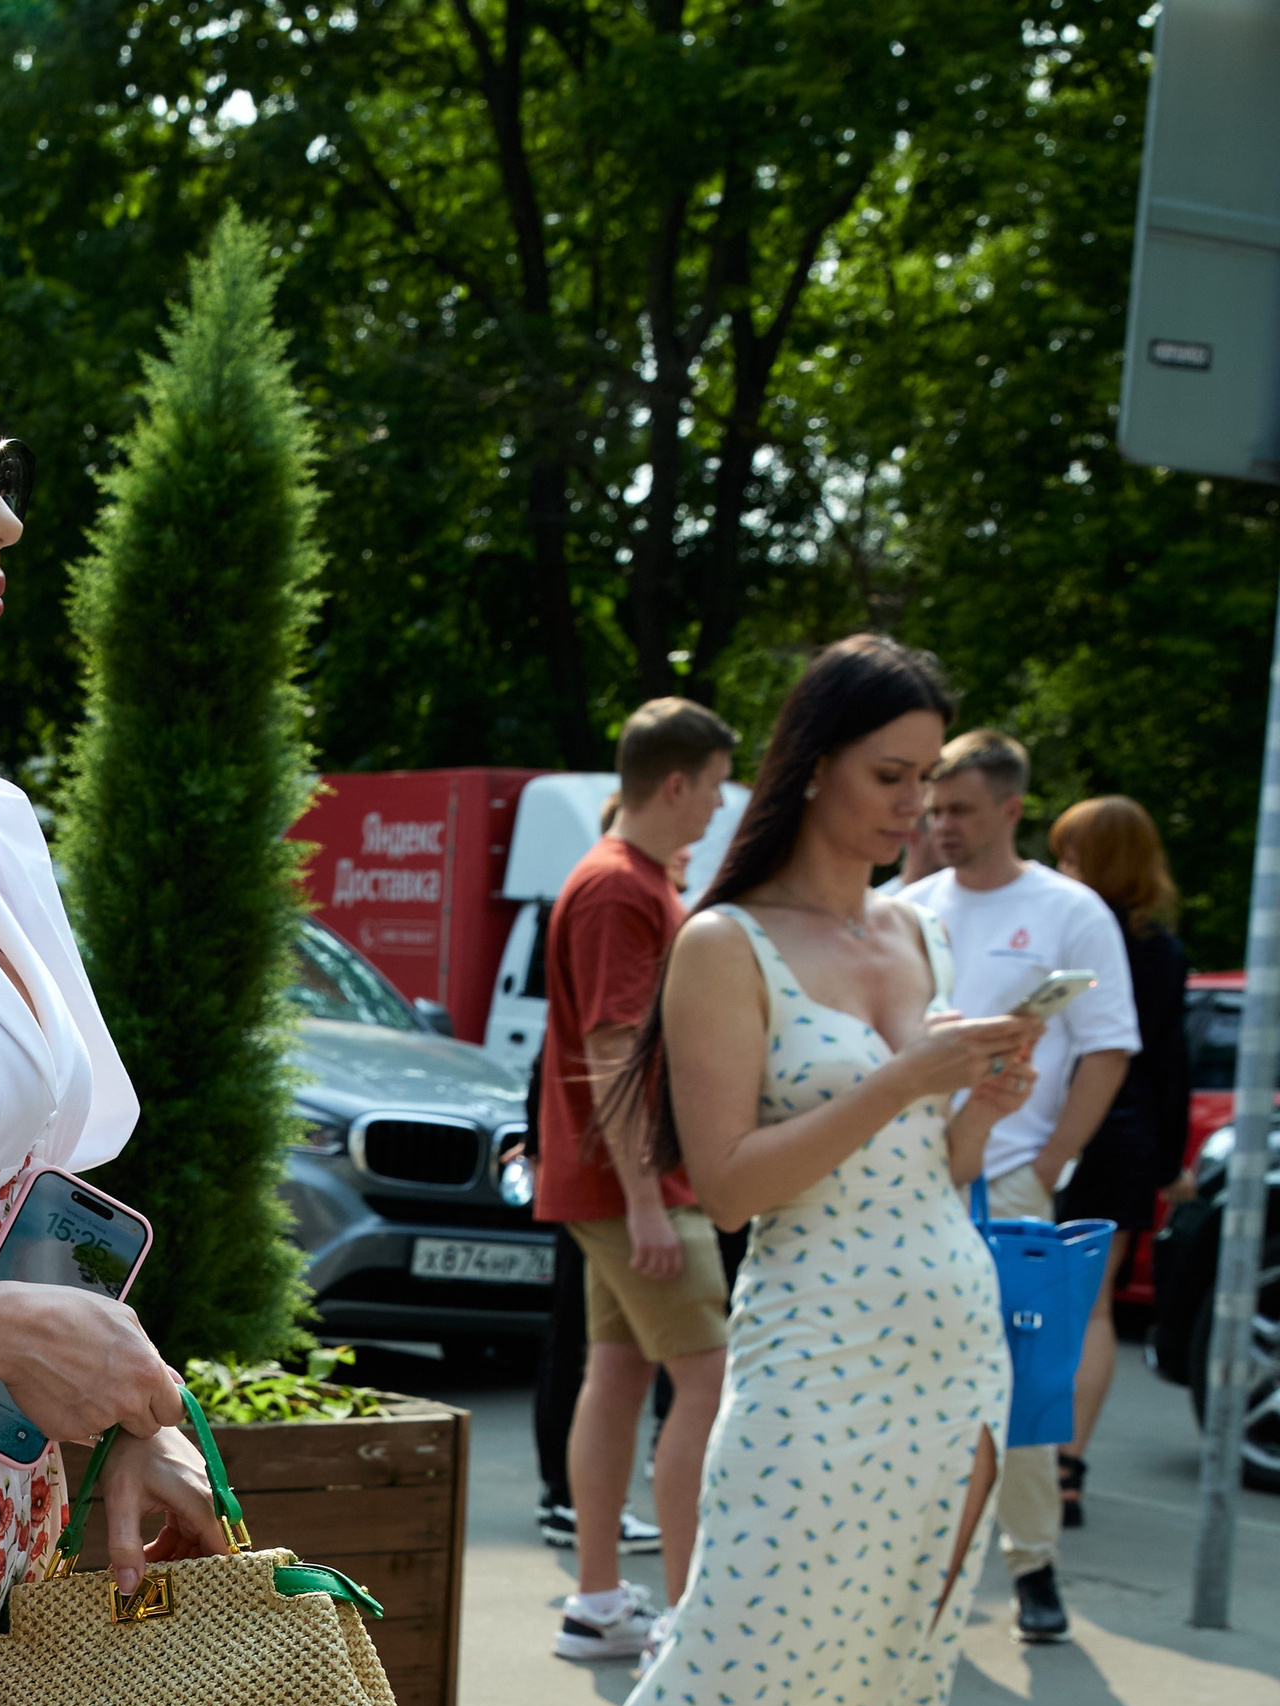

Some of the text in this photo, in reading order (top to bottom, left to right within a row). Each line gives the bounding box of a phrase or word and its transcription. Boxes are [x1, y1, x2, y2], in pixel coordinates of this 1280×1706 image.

[361, 811, 445, 860] Яндекс
[332, 858, 440, 908] Доставка
[47, 1212, 112, 1260] 15:25
